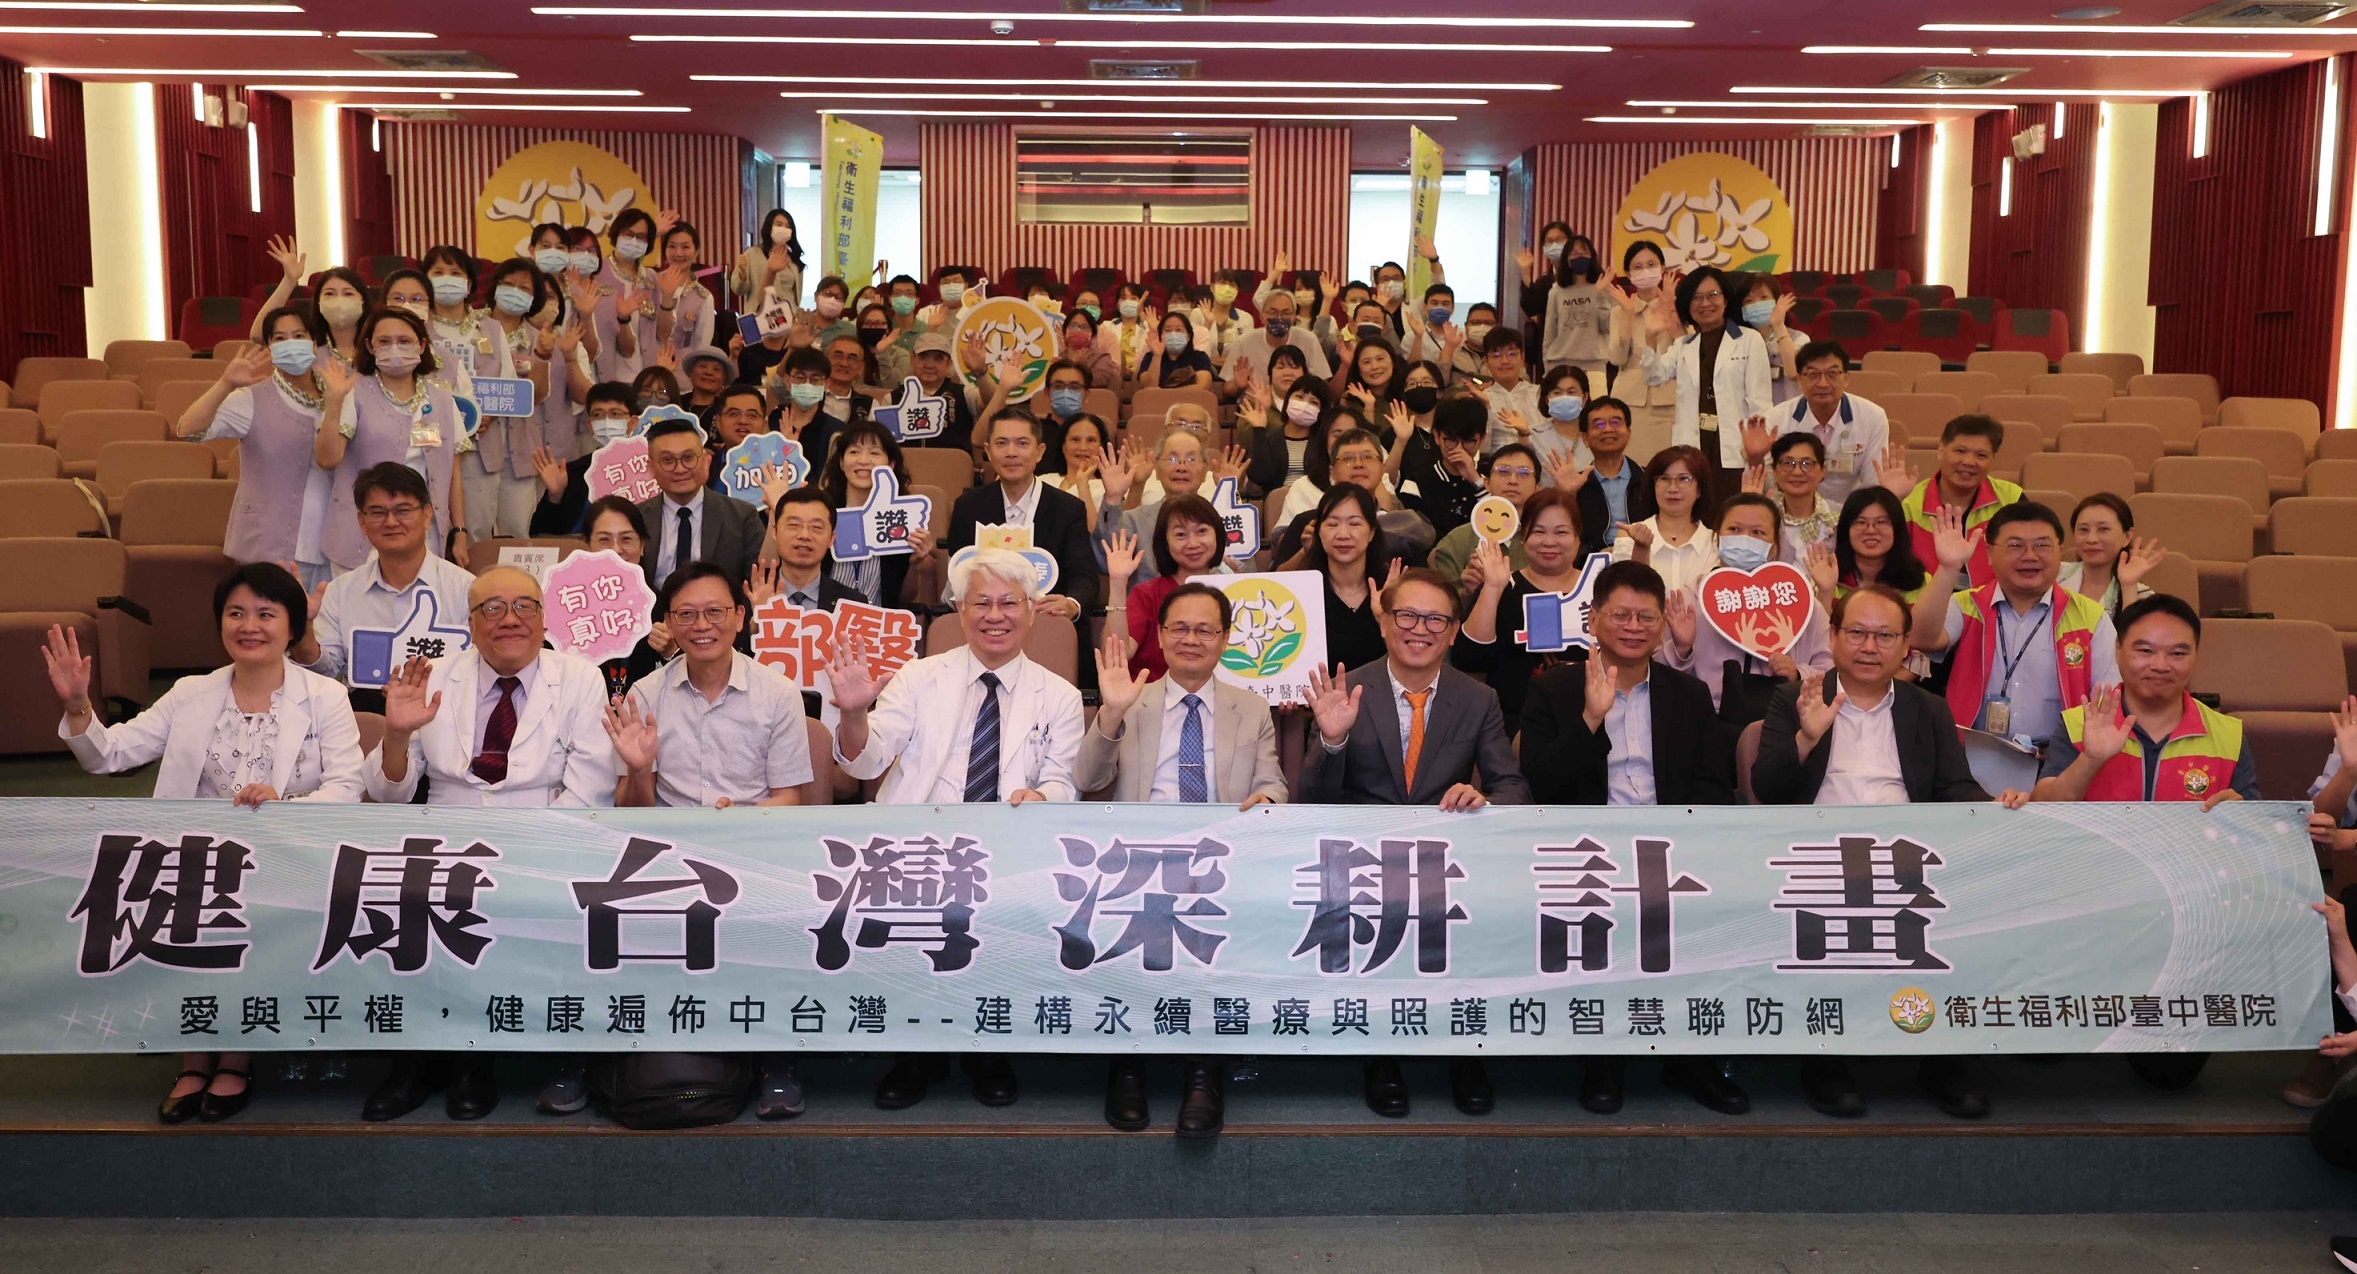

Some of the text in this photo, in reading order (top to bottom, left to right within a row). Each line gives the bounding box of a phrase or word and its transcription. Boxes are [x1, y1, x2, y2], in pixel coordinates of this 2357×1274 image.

[1562, 297, 1591, 306] NASA
[906, 407, 931, 431] 讚
[874, 509, 910, 544] 讚
[557, 574, 624, 613] 有你
[1714, 580, 1798, 614] 謝謝您
[566, 607, 636, 647] 真好
[66, 832, 1955, 976] 健康台灣深耕計畫
[1944, 993, 2277, 1030] 衛生福利部臺中醫院
